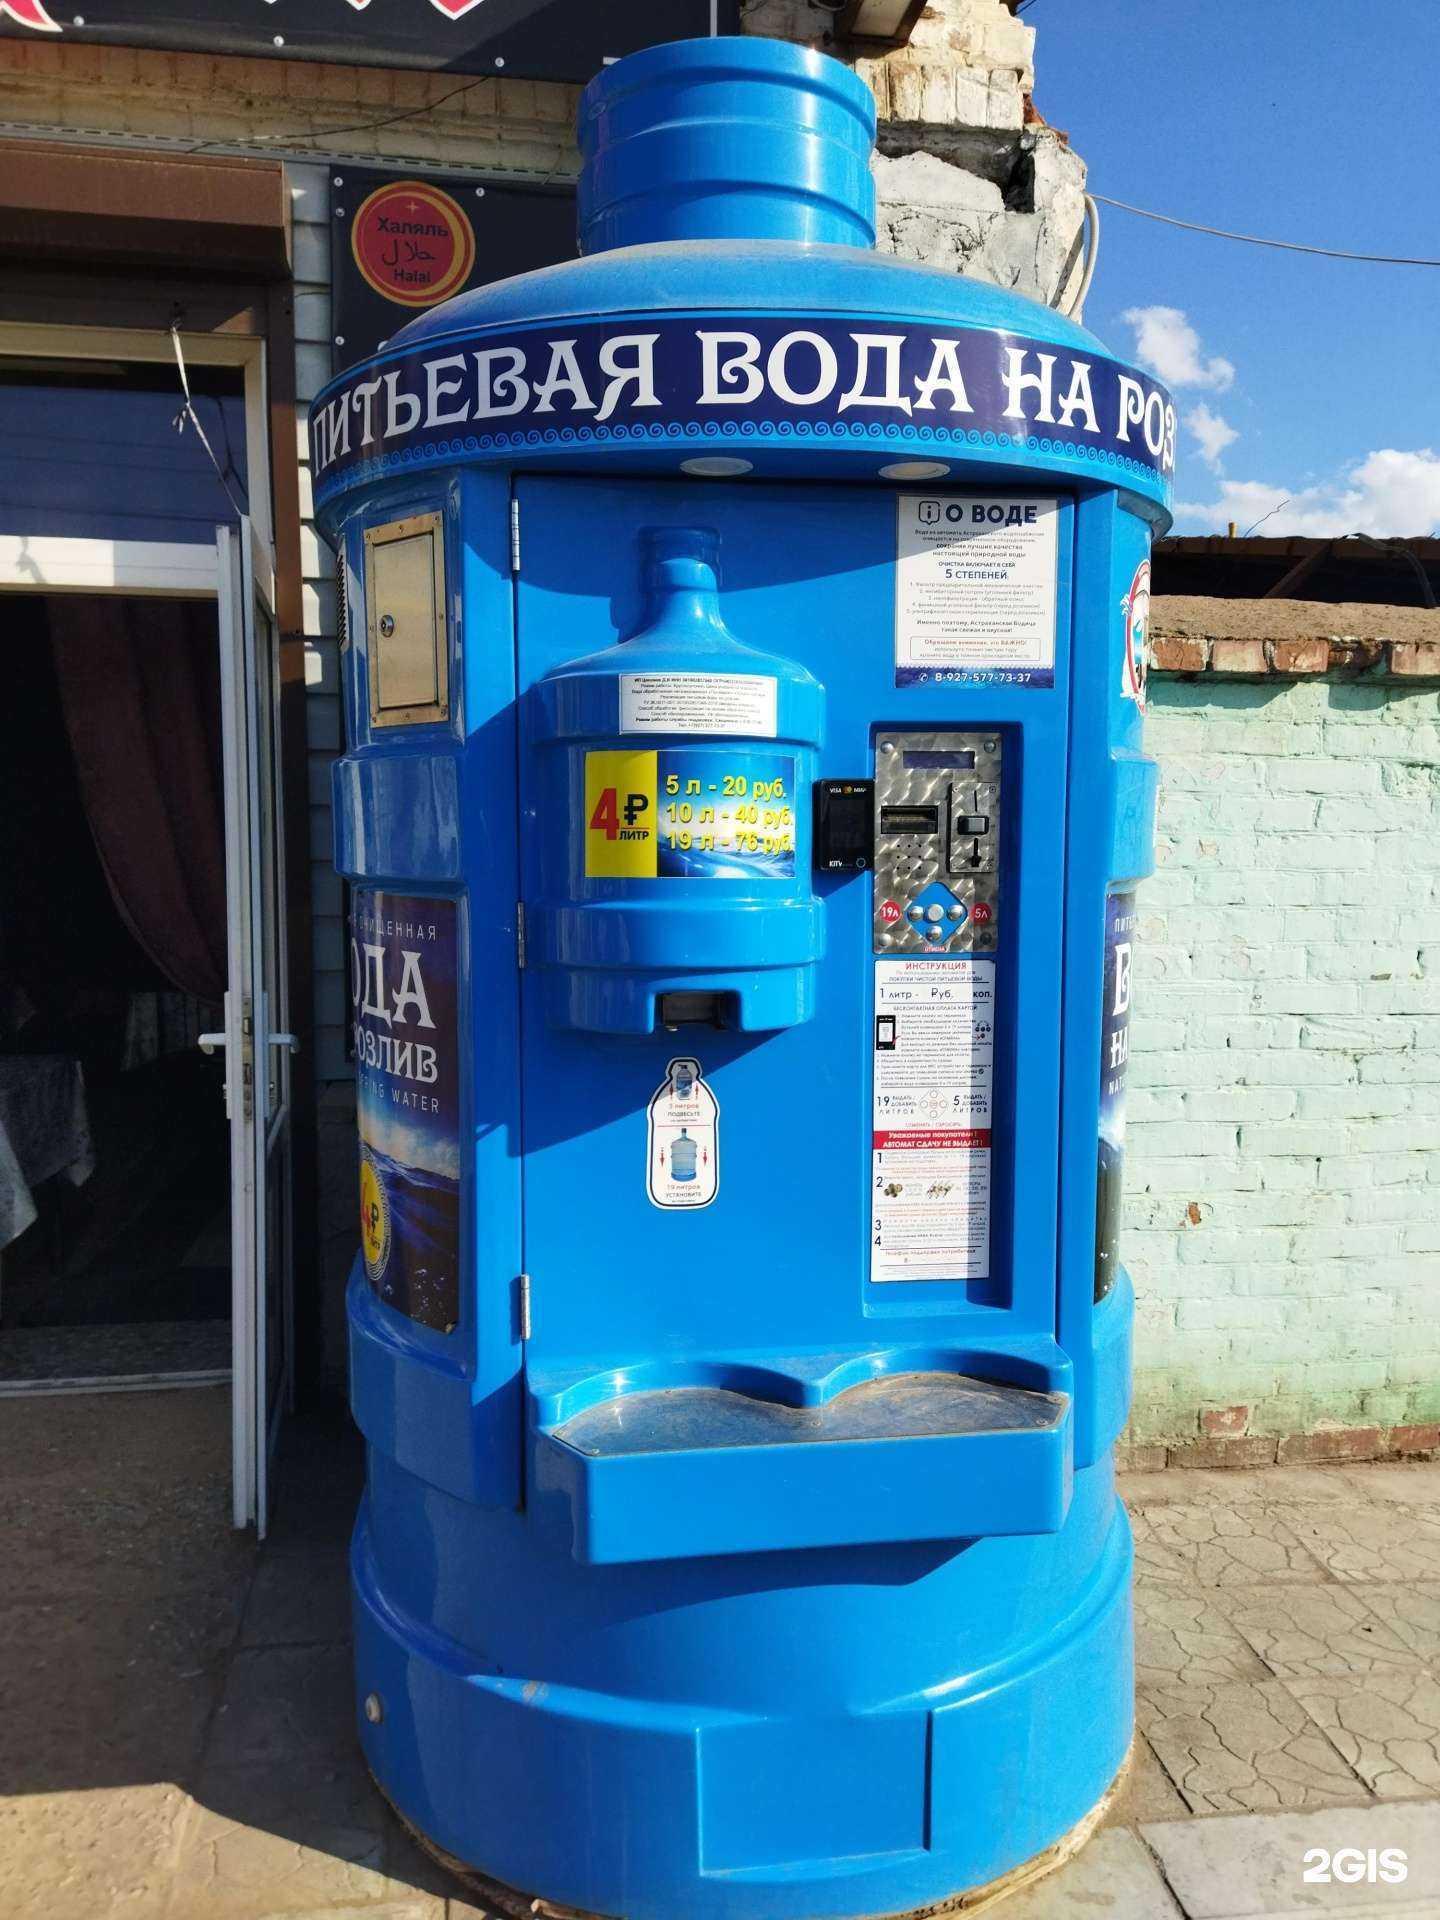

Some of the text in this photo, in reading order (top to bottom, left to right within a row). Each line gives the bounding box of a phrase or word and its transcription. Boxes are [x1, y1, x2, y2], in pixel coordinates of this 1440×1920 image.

[377, 216, 449, 237] Халяль
[381, 240, 437, 266] حلال
[393, 269, 432, 283] Halal
[313, 331, 1177, 478] ПИТЬЕВАЯ ВОДА НА РОЗ
[946, 504, 1037, 527] О ВОДЕ
[945, 568, 1008, 580] 5 СТЕПЕНЕЙ
[934, 672, 1031, 683] 8-927-577-73-37
[666, 774, 679, 796] 5
[685, 778, 701, 795] л
[723, 776, 747, 796] 20
[753, 777, 787, 801] руб.
[590, 788, 620, 841] 4
[666, 803, 692, 824] 10
[699, 806, 715, 824] л
[735, 804, 758, 824] 40
[763, 807, 793, 829] руб.
[619, 831, 649, 841] ЛИТР
[666, 831, 692, 851] 19
[699, 834, 715, 851] л
[763, 833, 794, 856] руб.
[905, 962, 967, 971] ИНСТРУКЦИЯ
[880, 988, 884, 998] 1
[391, 1087, 439, 1114] WATER
[877, 1096, 890, 1107] 19
[953, 1095, 960, 1106] 5
[883, 1140, 915, 1148] АВТОМАТ
[916, 1140, 943, 1148] СДАЧУ
[954, 1139, 979, 1147] ВЫДАЕТ
[877, 1152, 882, 1163] 1
[876, 1176, 883, 1188] 2
[875, 1220, 882, 1231] 3
[875, 1236, 882, 1246] 4
